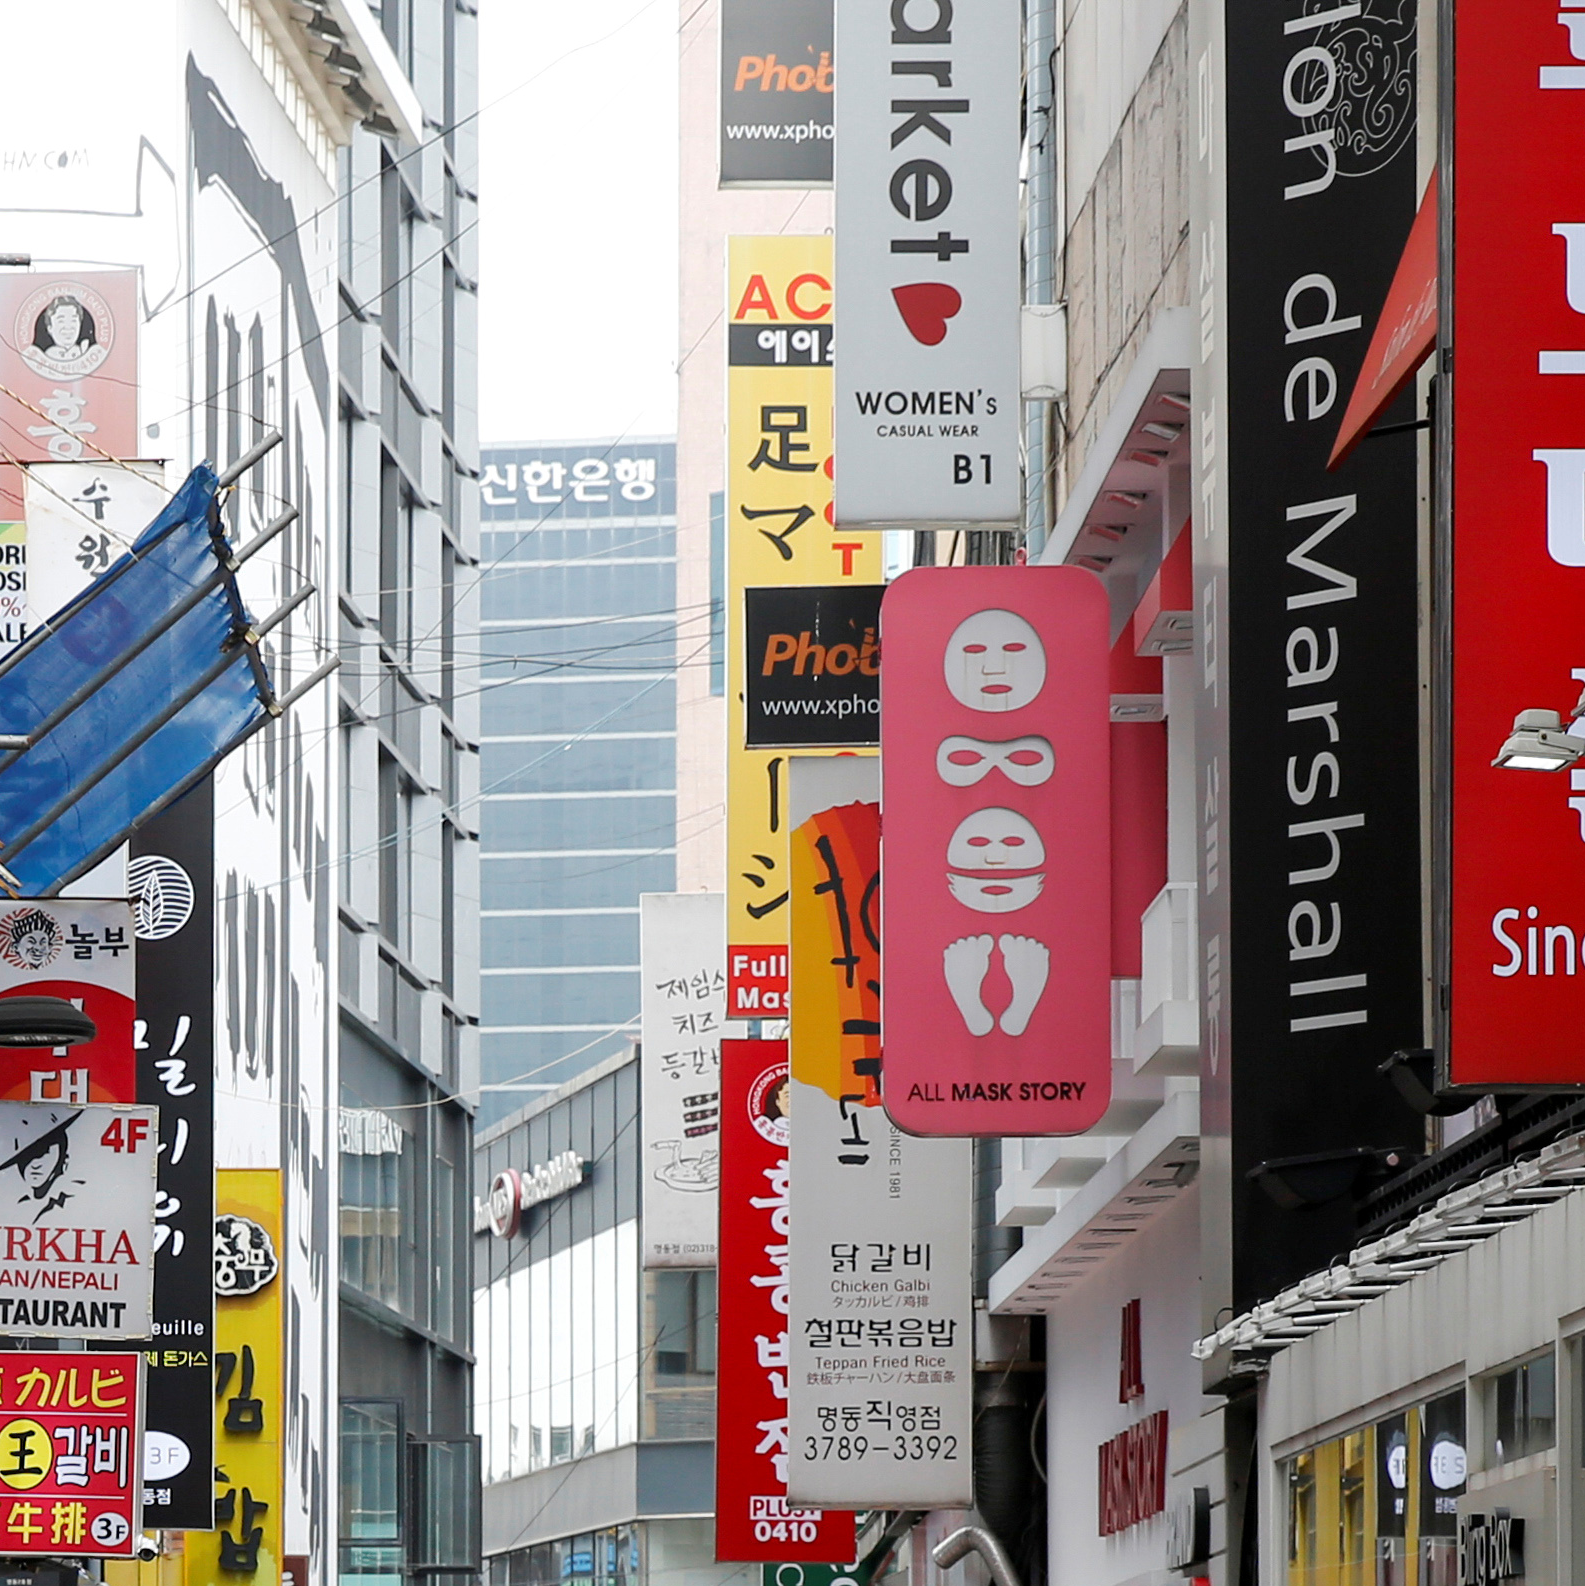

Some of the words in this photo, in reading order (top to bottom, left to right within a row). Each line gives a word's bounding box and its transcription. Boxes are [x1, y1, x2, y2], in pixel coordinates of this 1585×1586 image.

[734, 273, 832, 321] AC
[1282, 271, 1362, 423] de
[854, 387, 998, 417] WOMEN's
[876, 424, 933, 438] CASUAL
[938, 424, 980, 438] WEAR
[479, 457, 657, 506] 신한은행
[952, 453, 993, 485] B1
[1285, 493, 1368, 1033] Marshall
[65, 923, 130, 960] 놀부
[732, 954, 788, 978] Full
[908, 1083, 946, 1103] ALL
[951, 1082, 1014, 1102] MASK
[1018, 1081, 1087, 1102] STORY
[99, 1117, 149, 1155] 4F
[830, 1243, 932, 1273] 닭갈비
[830, 1279, 889, 1293] Chicken
[893, 1278, 931, 1292] Galbi
[802, 1318, 958, 1349] 철판볶음밥
[814, 1355, 869, 1372] Teppan
[872, 1354, 909, 1369] Fried
[913, 1353, 946, 1369] Rice
[816, 1400, 943, 1433] 명동직영점
[802, 1435, 958, 1462] 3789-3392
[95, 1517, 127, 1541] 3F
[754, 1520, 817, 1543] 0410
